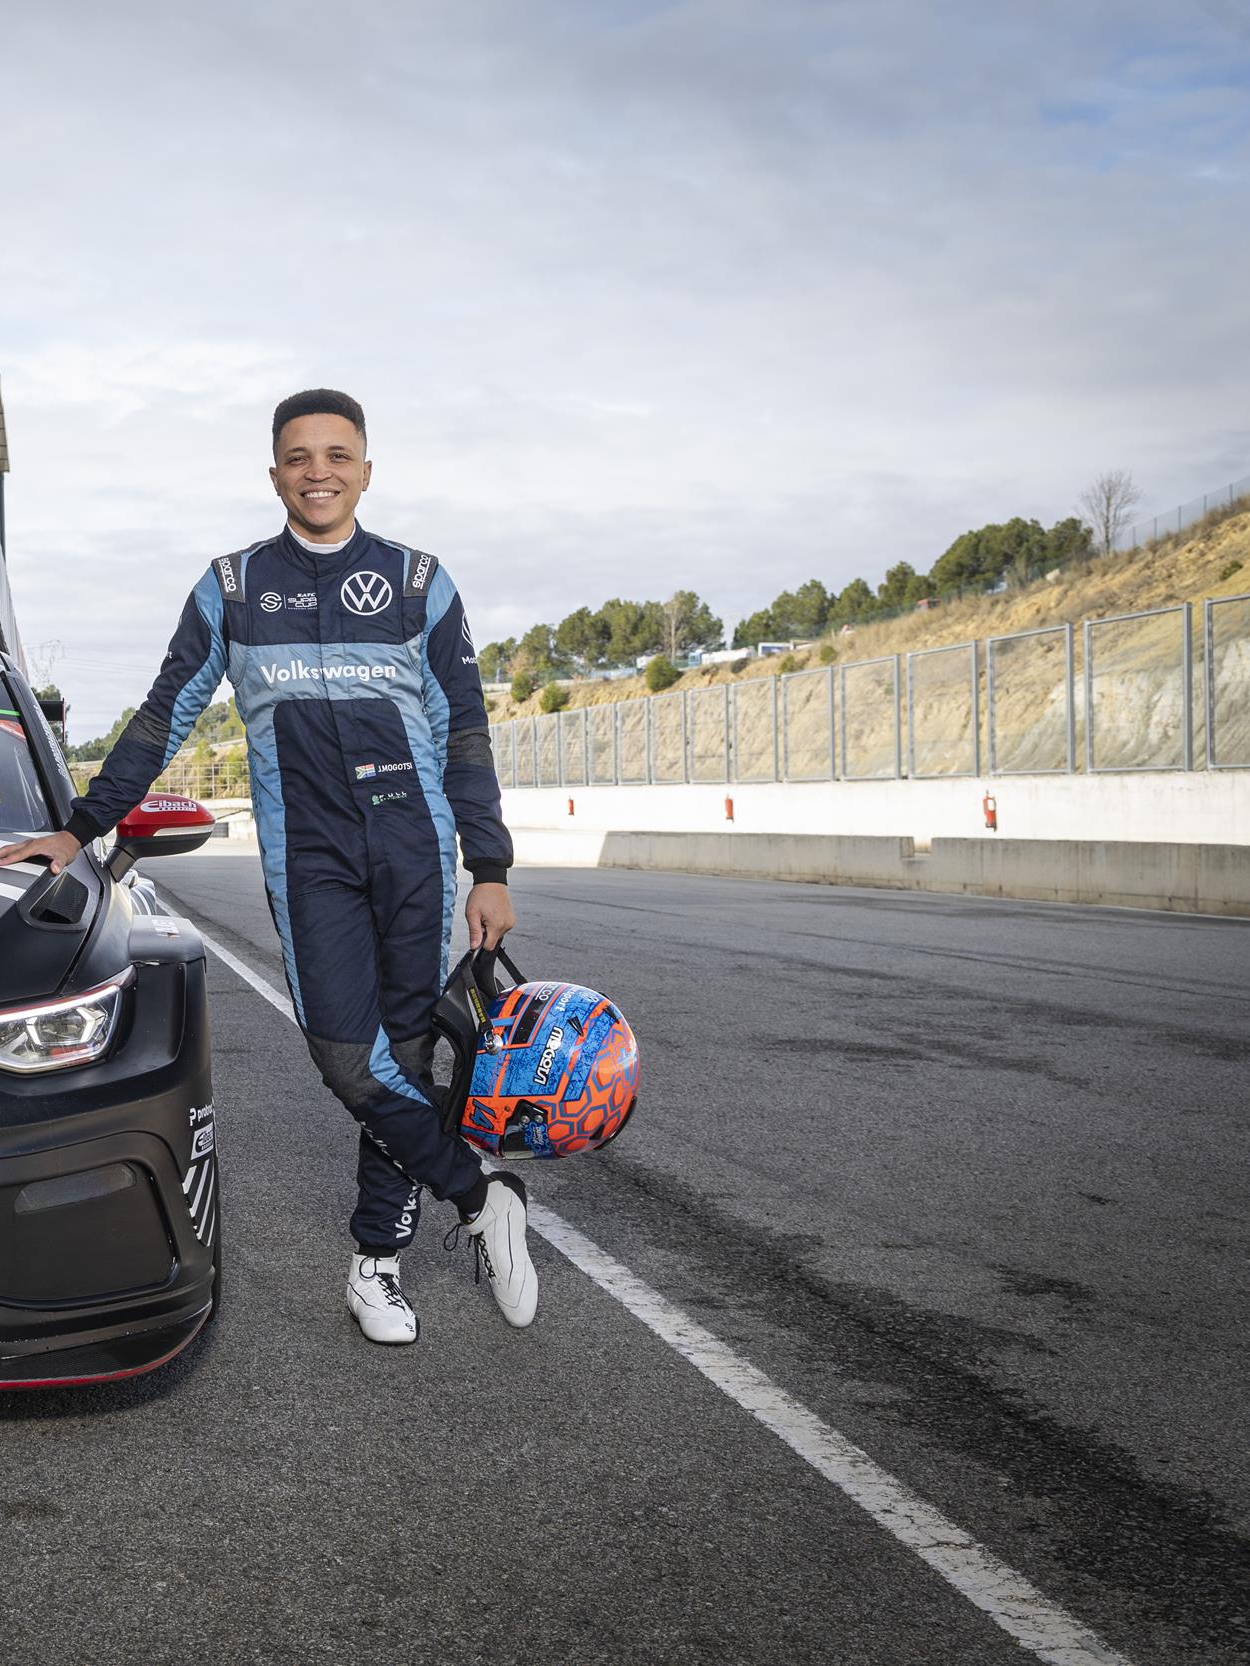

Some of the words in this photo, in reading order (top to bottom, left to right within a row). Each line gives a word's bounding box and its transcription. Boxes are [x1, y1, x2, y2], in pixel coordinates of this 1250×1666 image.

[219, 557, 237, 592] sparco
[412, 554, 431, 590] sparco
[260, 659, 396, 684] Volkswagen
[140, 800, 198, 812] Eibach
